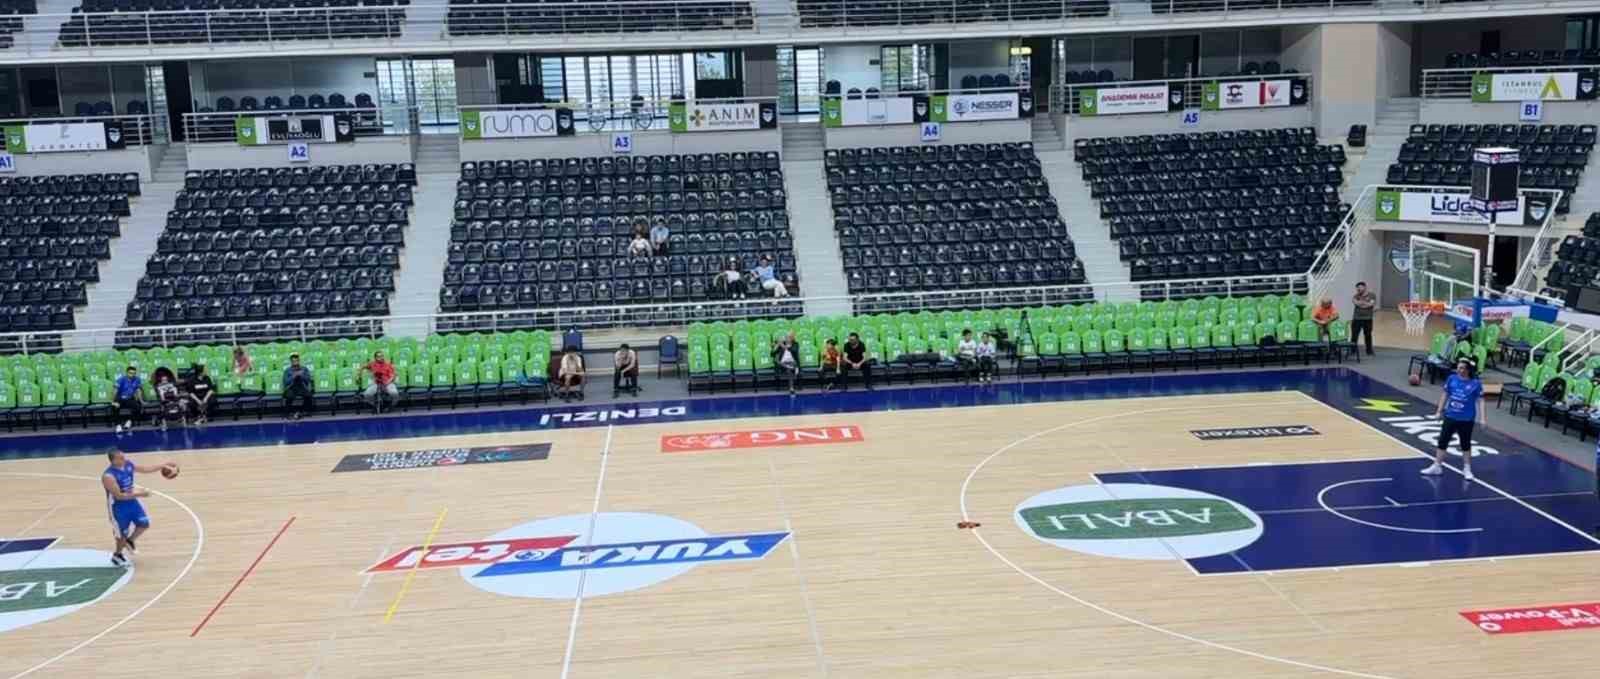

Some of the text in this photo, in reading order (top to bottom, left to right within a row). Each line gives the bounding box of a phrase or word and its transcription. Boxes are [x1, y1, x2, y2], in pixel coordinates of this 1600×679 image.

[709, 107, 755, 120] ANIM
[1525, 104, 1538, 115] B1
[483, 113, 554, 133] ruma
[1184, 113, 1198, 123] A5
[924, 126, 938, 136] A4
[614, 137, 629, 148] A3
[291, 147, 306, 157] A2
[1431, 195, 1474, 212] Lide
[539, 404, 687, 425] DENİZLİ
[751, 427, 859, 444] ING
[1046, 506, 1212, 530] ABALI
[401, 538, 753, 569] YUKA tel
[1479, 607, 1593, 621] V-Power
